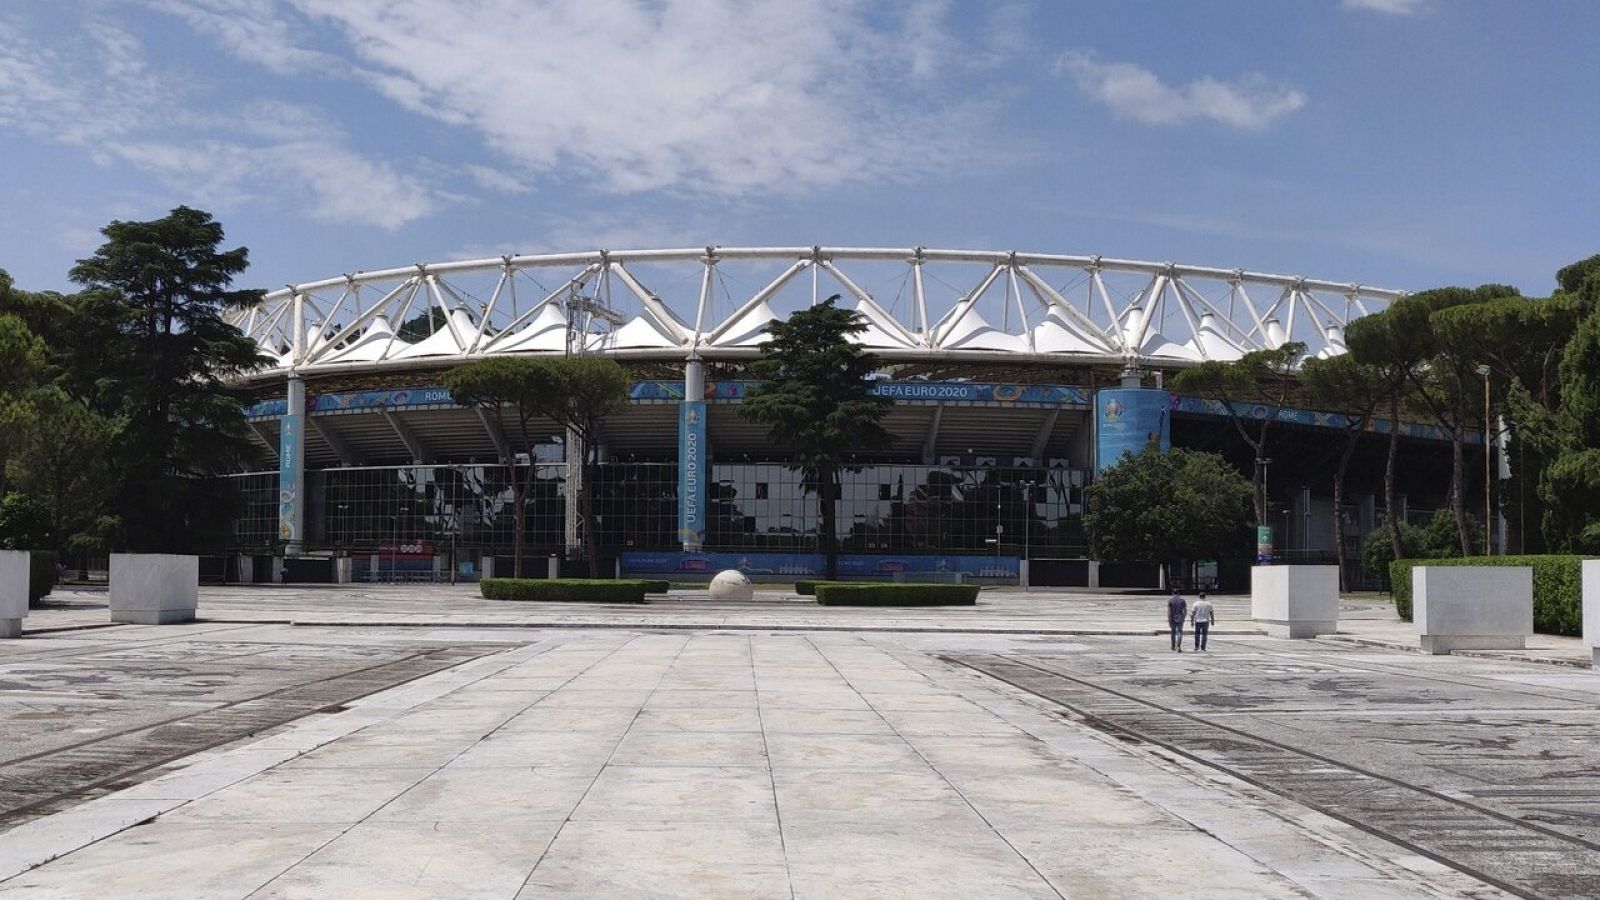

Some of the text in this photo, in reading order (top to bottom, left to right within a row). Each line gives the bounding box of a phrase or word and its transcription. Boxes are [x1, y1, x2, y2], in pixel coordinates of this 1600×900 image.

[904, 386, 937, 396] EURO
[939, 387, 968, 397] 2020
[687, 433, 697, 524] UEFA EURO 2020
